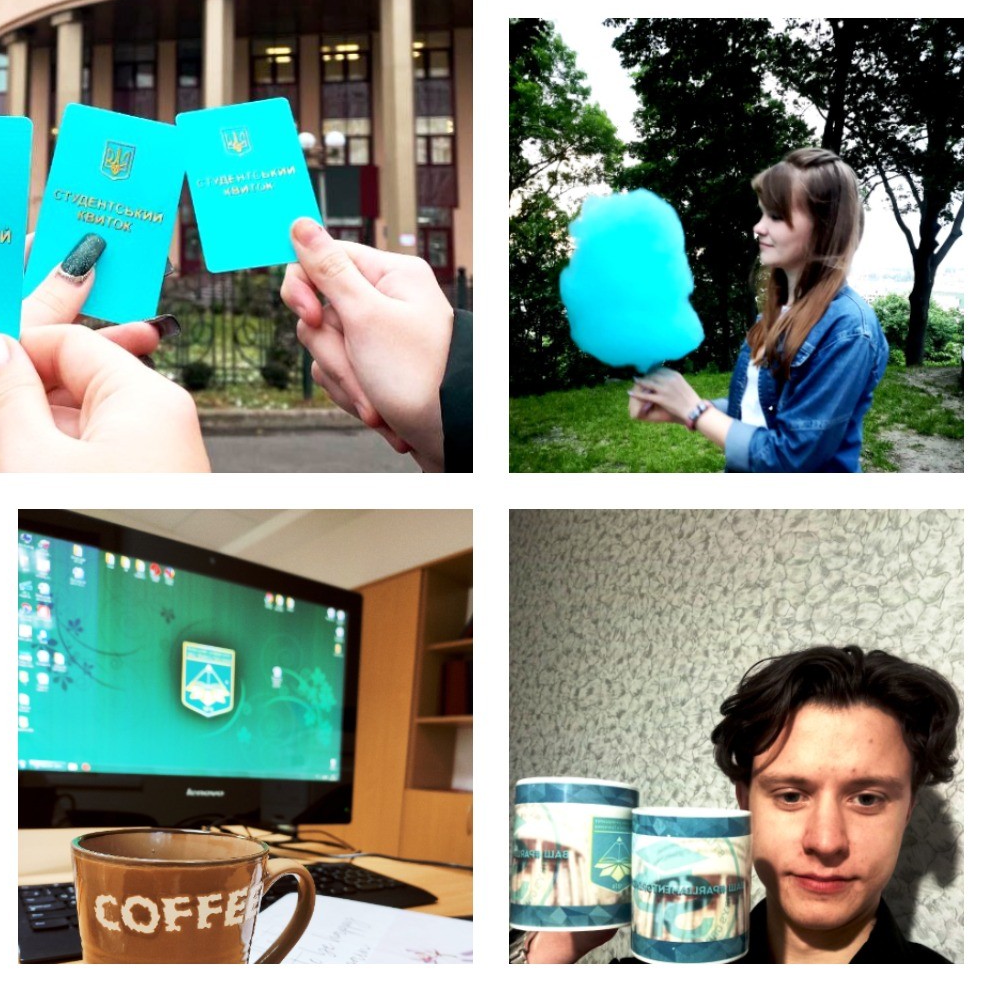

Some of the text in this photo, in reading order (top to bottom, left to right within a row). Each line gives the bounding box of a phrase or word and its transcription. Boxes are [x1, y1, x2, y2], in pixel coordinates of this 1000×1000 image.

[196, 165, 296, 188] СТУДЕНТСЬКИЙ
[224, 182, 274, 196] КВИТОК
[54, 188, 164, 224] СТУДЕНТСЬКИЙ
[77, 210, 133, 233] КВИТОК
